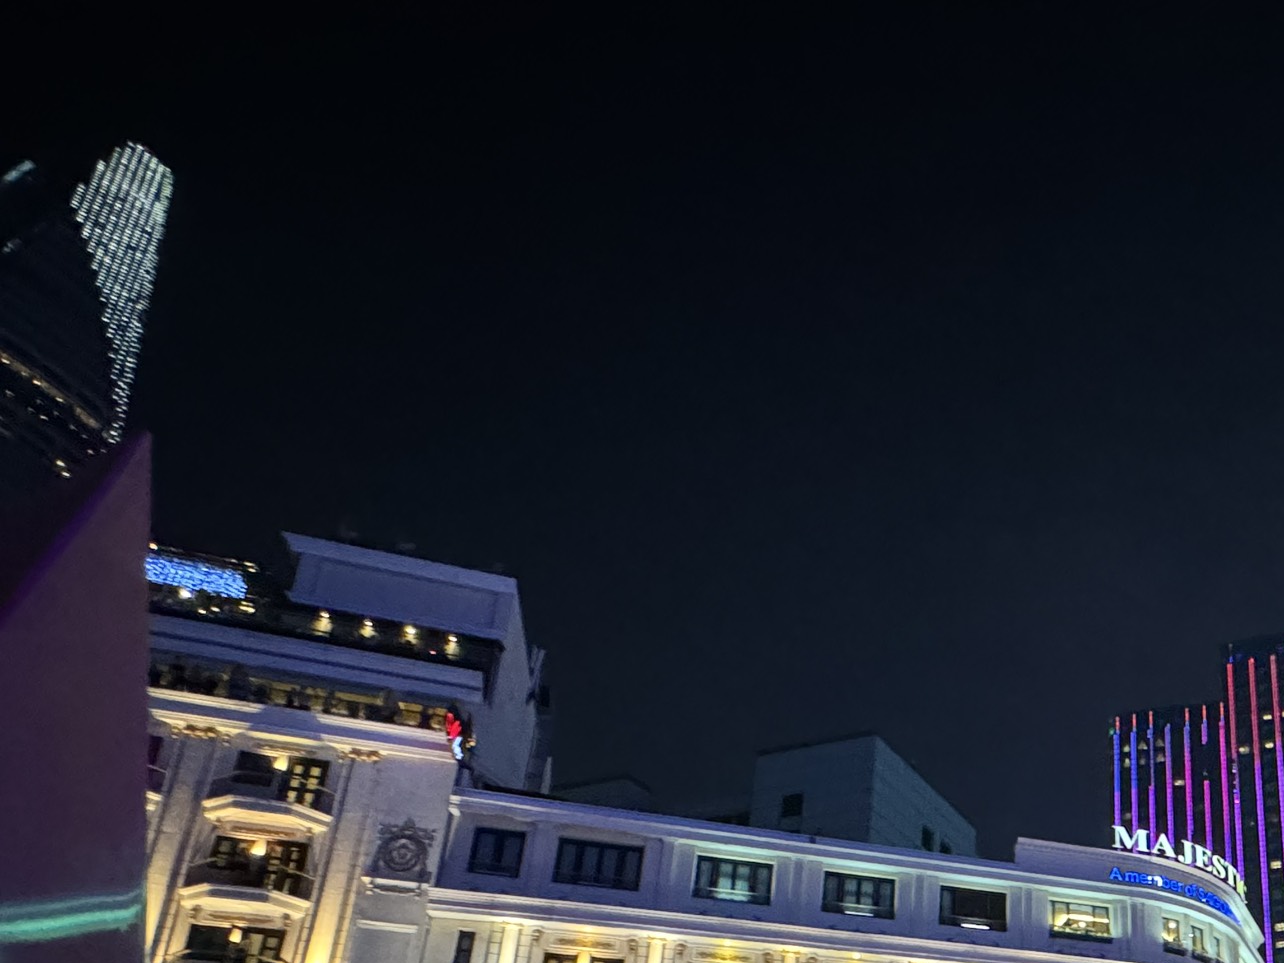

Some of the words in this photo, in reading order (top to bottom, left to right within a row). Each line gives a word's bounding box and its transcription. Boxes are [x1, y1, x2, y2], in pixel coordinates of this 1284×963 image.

[1109, 867, 1122, 880] A
[1185, 883, 1197, 898] of
[1111, 825, 1248, 904] MAJESTI
